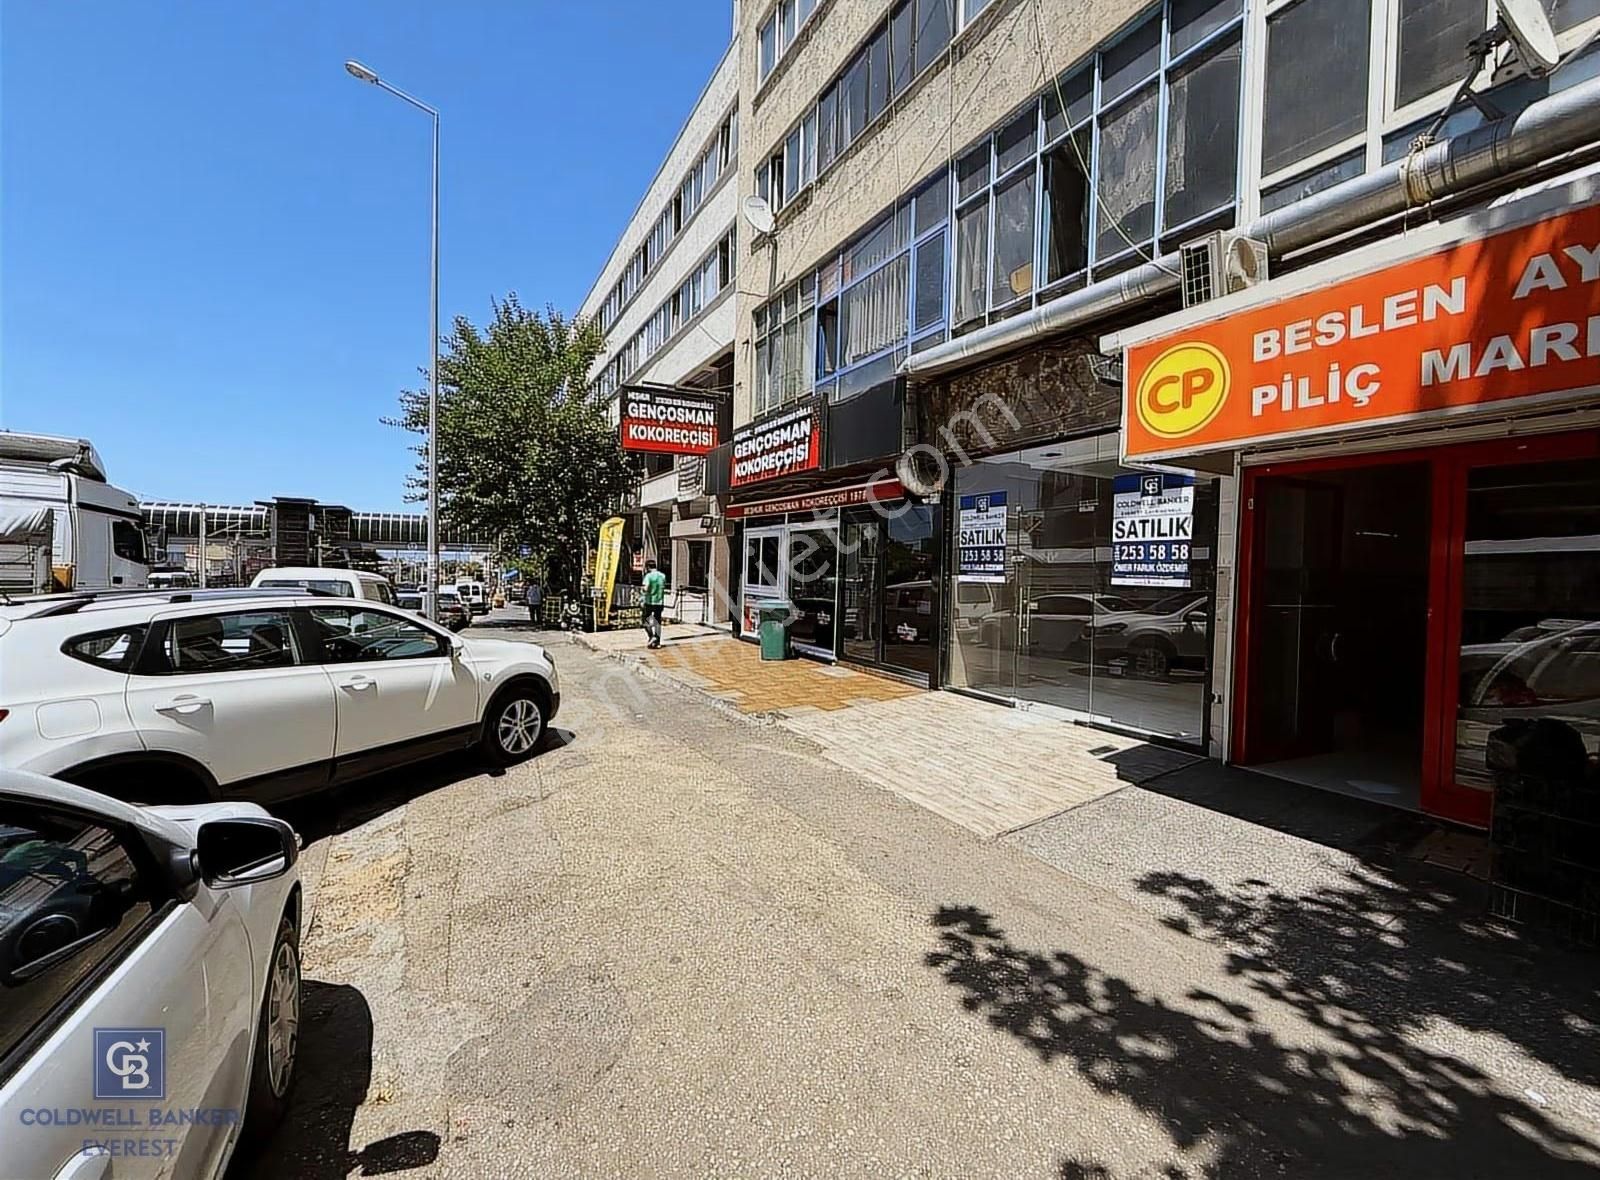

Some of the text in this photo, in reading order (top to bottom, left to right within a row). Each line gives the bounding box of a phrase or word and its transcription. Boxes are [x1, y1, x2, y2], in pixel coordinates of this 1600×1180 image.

[1252, 244, 1600, 364] BESLEN AY
[1251, 315, 1600, 417] PİLİÇ MAR
[1147, 366, 1216, 415] CP
[627, 402, 714, 426] GENÇOSMAN
[628, 424, 713, 449] KOKOREÇÇİSİ
[734, 418, 811, 459] GENÇOSMAN
[734, 437, 809, 477] KOKOREÇÇİSİ
[1116, 496, 1190, 508] COLDWELL BANKER
[960, 528, 1005, 546] SATILIK
[1114, 516, 1190, 539] SATILIK
[964, 549, 979, 562] 253
[981, 549, 992, 562] 58
[993, 549, 1004, 562] 58
[1120, 545, 1145, 560] 253
[1149, 544, 1166, 560] 58
[1171, 544, 1189, 560] 58
